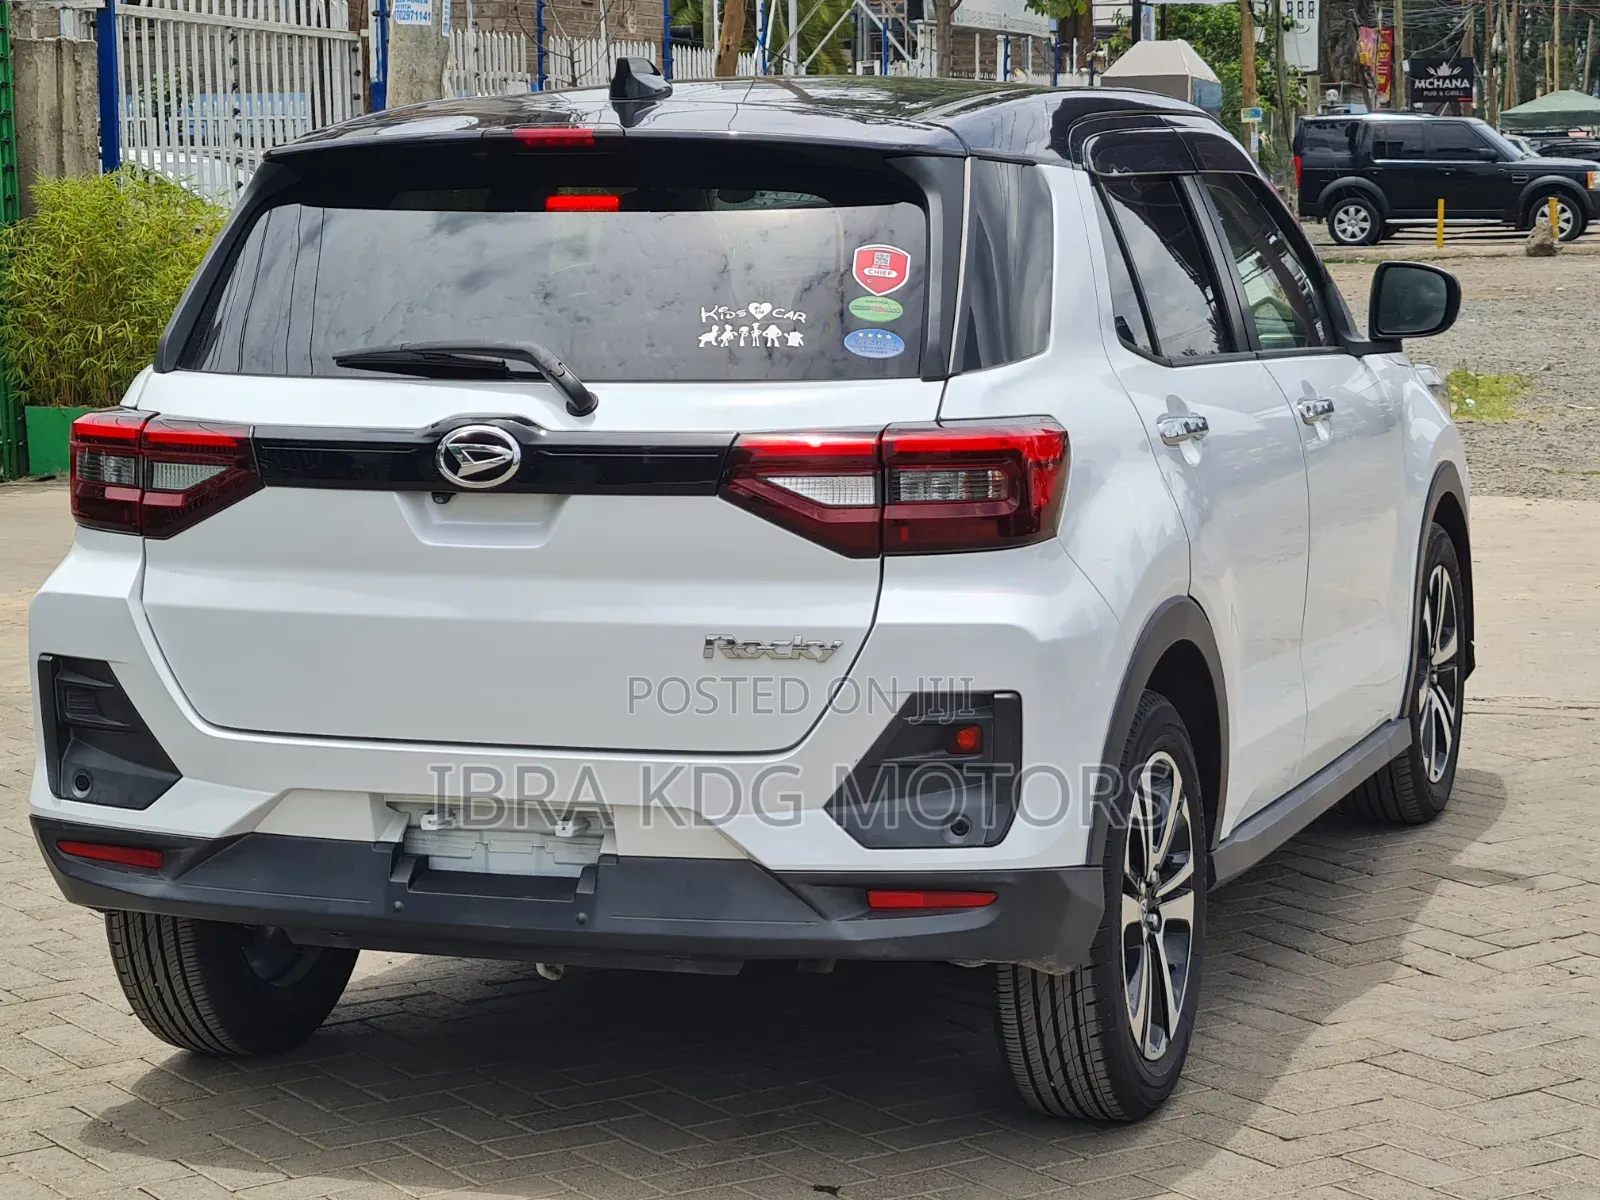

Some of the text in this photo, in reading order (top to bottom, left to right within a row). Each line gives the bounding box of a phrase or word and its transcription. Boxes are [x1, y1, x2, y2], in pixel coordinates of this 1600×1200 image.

[1414, 78, 1470, 89] MCHANA
[867, 268, 893, 277] CHIEF
[771, 308, 807, 324] CAR
[702, 633, 844, 663] Rocky
